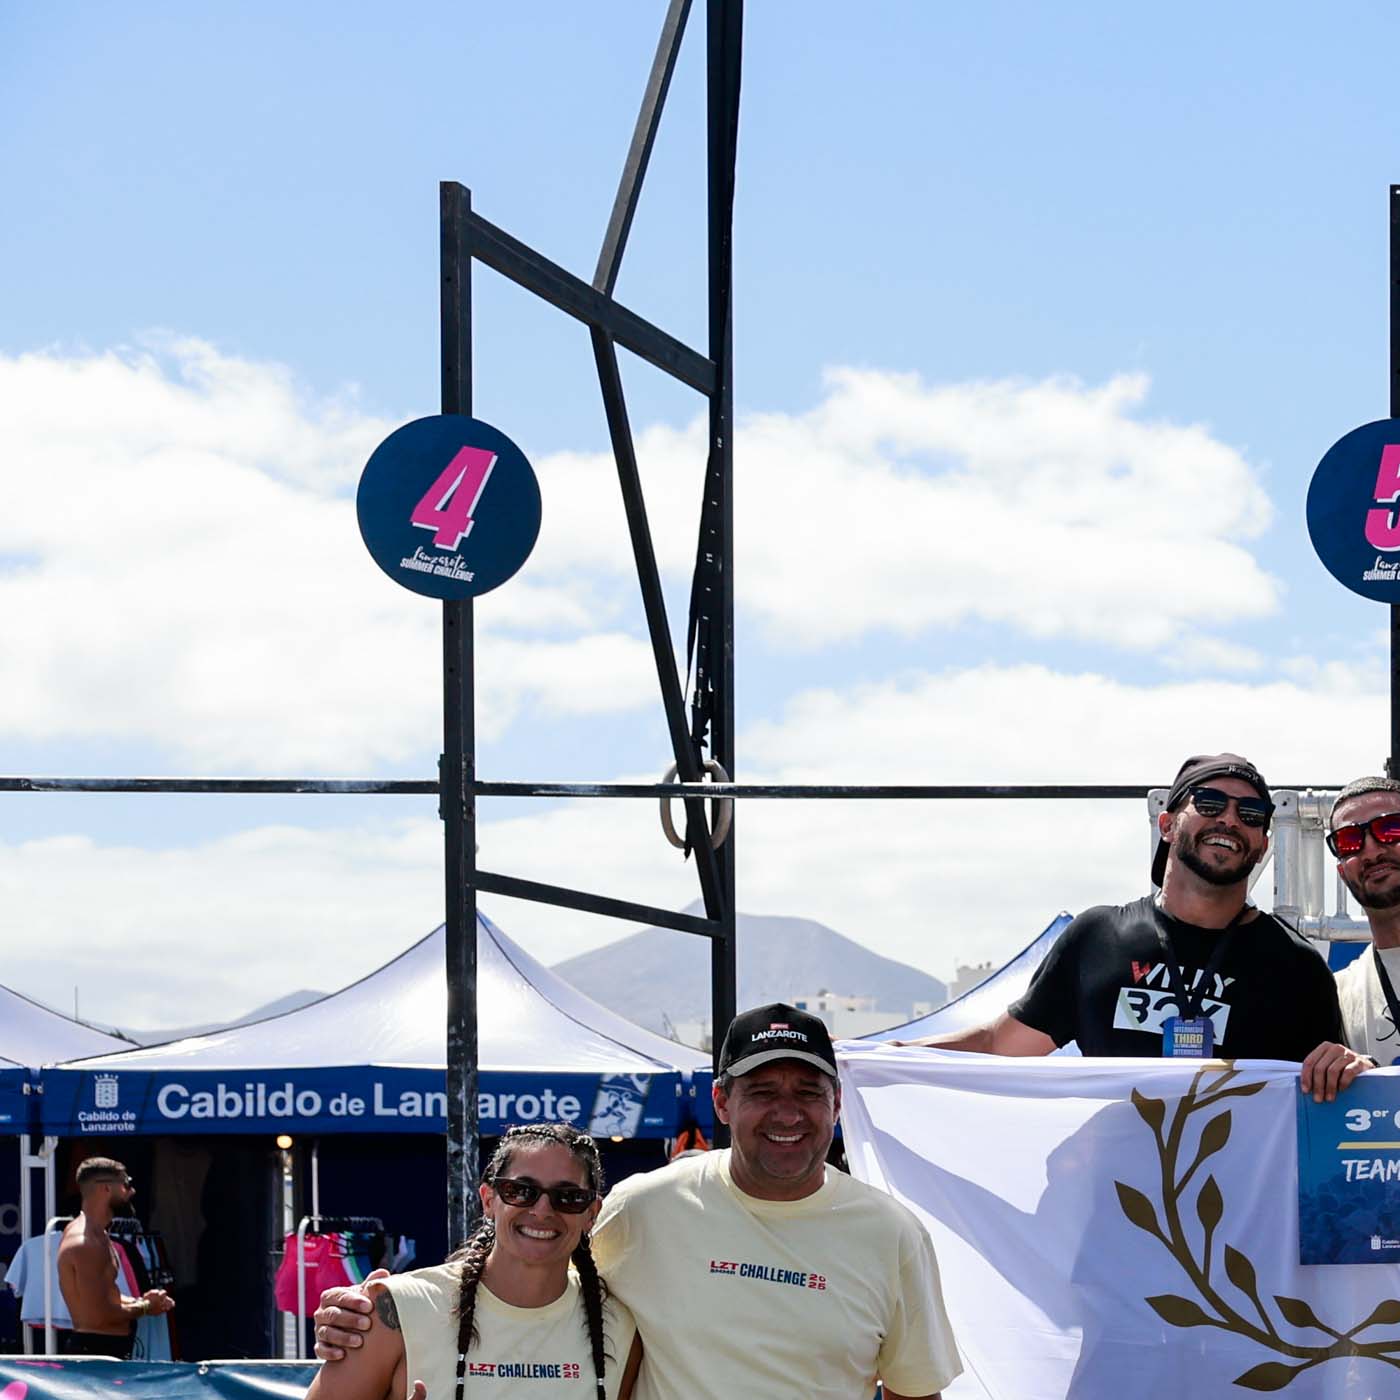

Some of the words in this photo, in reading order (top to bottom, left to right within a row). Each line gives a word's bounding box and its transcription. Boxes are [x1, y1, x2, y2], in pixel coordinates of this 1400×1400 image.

[410, 445, 498, 551] 4
[400, 557, 433, 574] SUMMER
[433, 565, 475, 582] CHALLENGE
[1363, 570, 1395, 581] SUMMER
[752, 1030, 808, 1043] LANZAROTE
[1174, 1034, 1203, 1044] THIRD
[157, 1083, 321, 1119] Cabildo
[330, 1092, 365, 1116] de
[374, 1082, 581, 1120] Lanarote
[78, 1112, 120, 1122] Cabildo
[121, 1111, 136, 1121] de
[81, 1121, 135, 1132] Lanzarote
[710, 1260, 739, 1270] LZT
[740, 1263, 807, 1287] CHALLENGE
[469, 1363, 496, 1371] LZT
[498, 1363, 561, 1378] CHALLENGE
